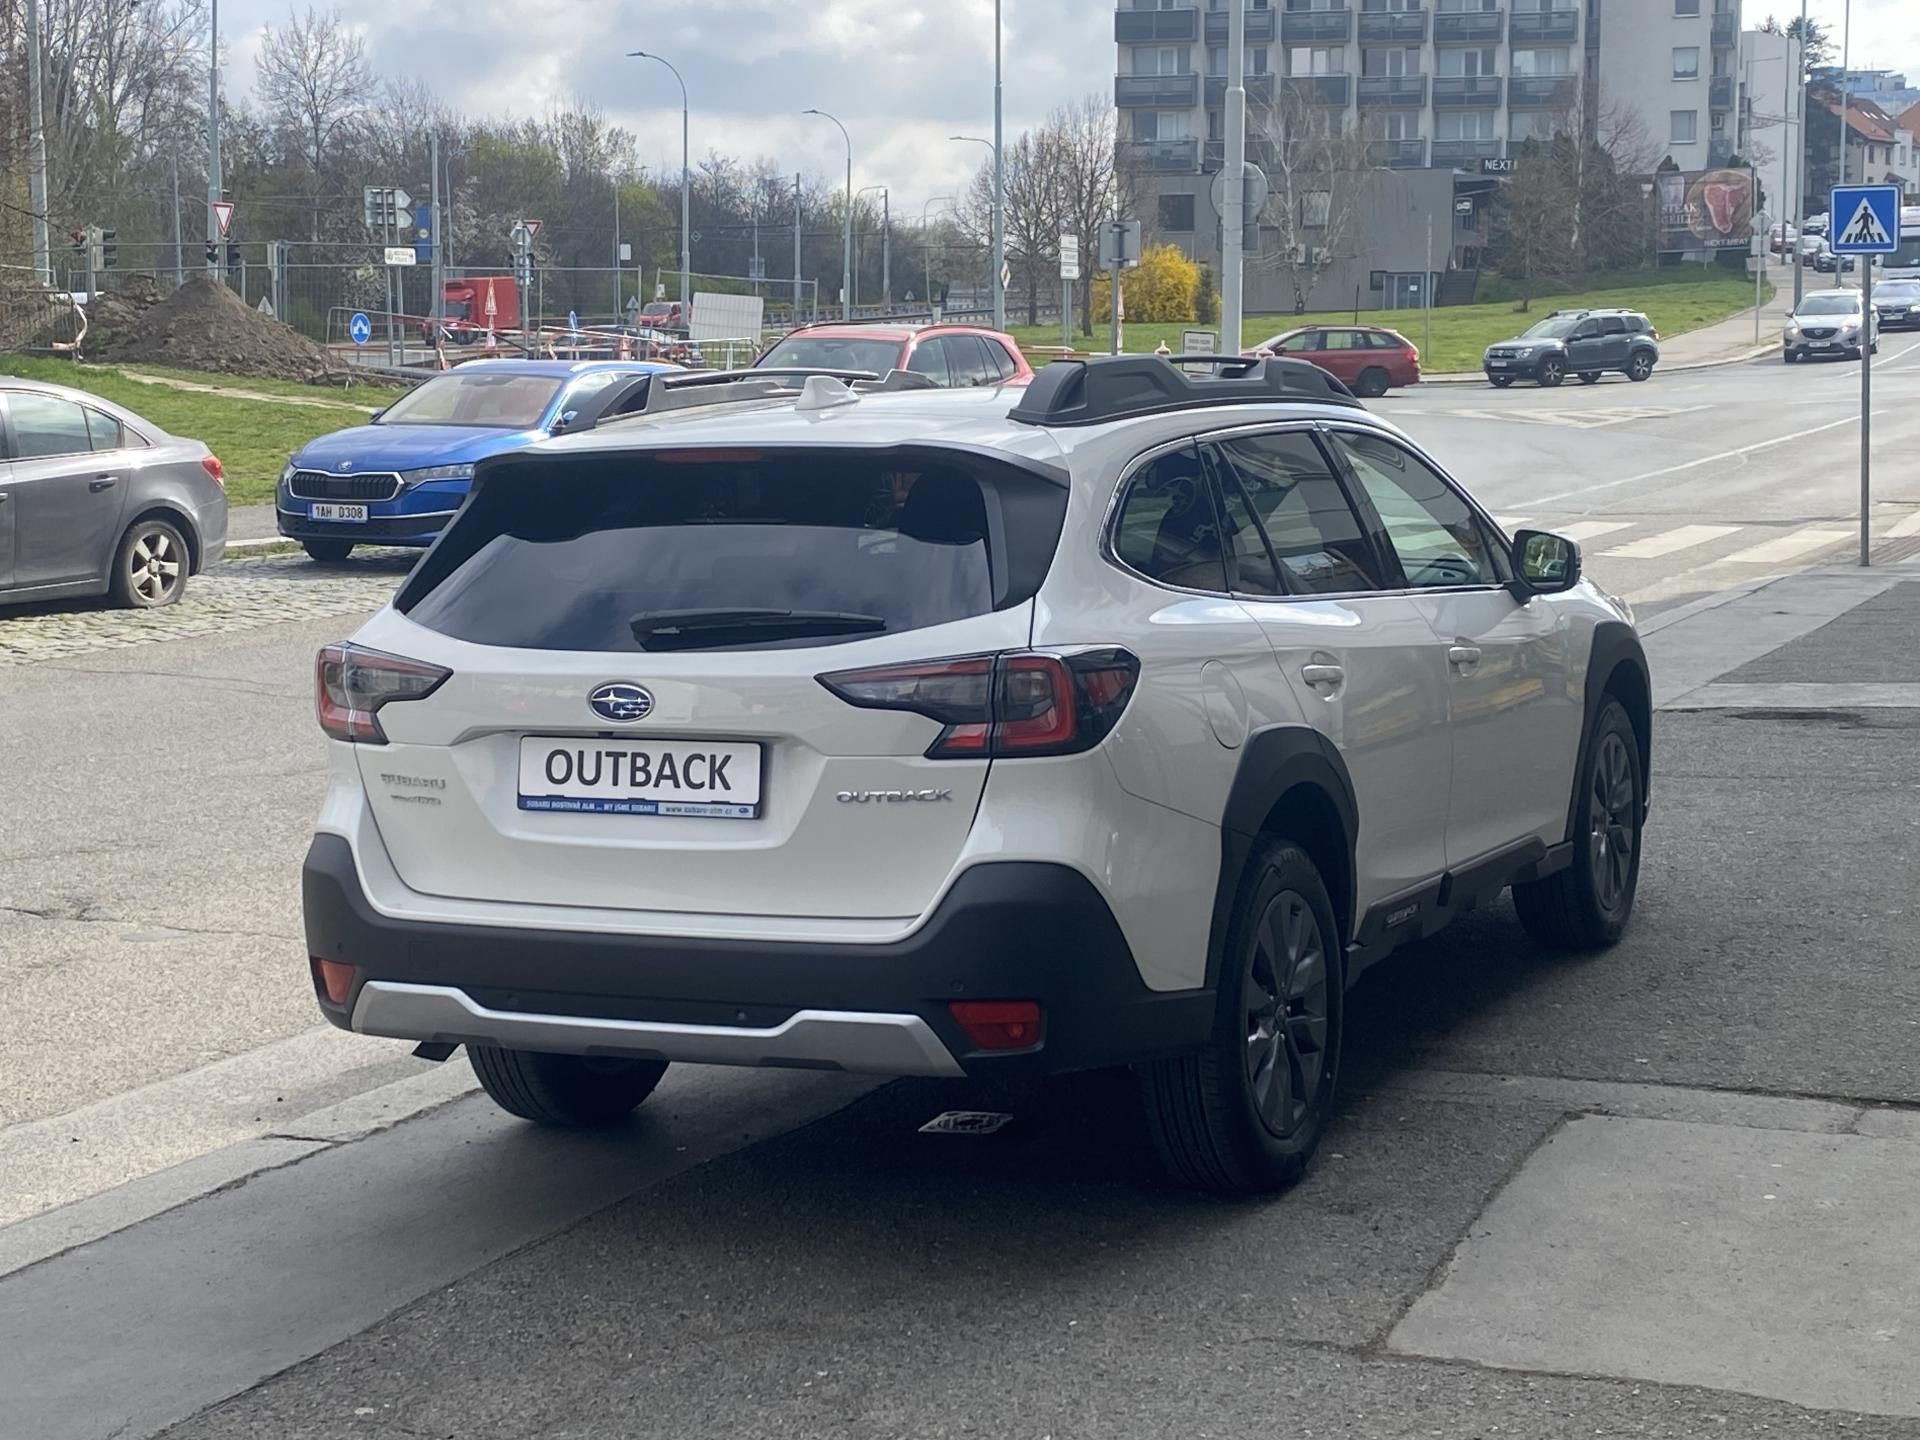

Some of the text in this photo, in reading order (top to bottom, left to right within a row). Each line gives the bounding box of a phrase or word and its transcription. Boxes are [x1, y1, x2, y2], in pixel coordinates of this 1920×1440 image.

[1484, 159, 1512, 170] NEXT
[1704, 239, 1726, 247] NEXT
[545, 749, 732, 791] OUTBACK
[836, 788, 953, 803] OUTBACK
[526, 800, 550, 808] SUBARU
